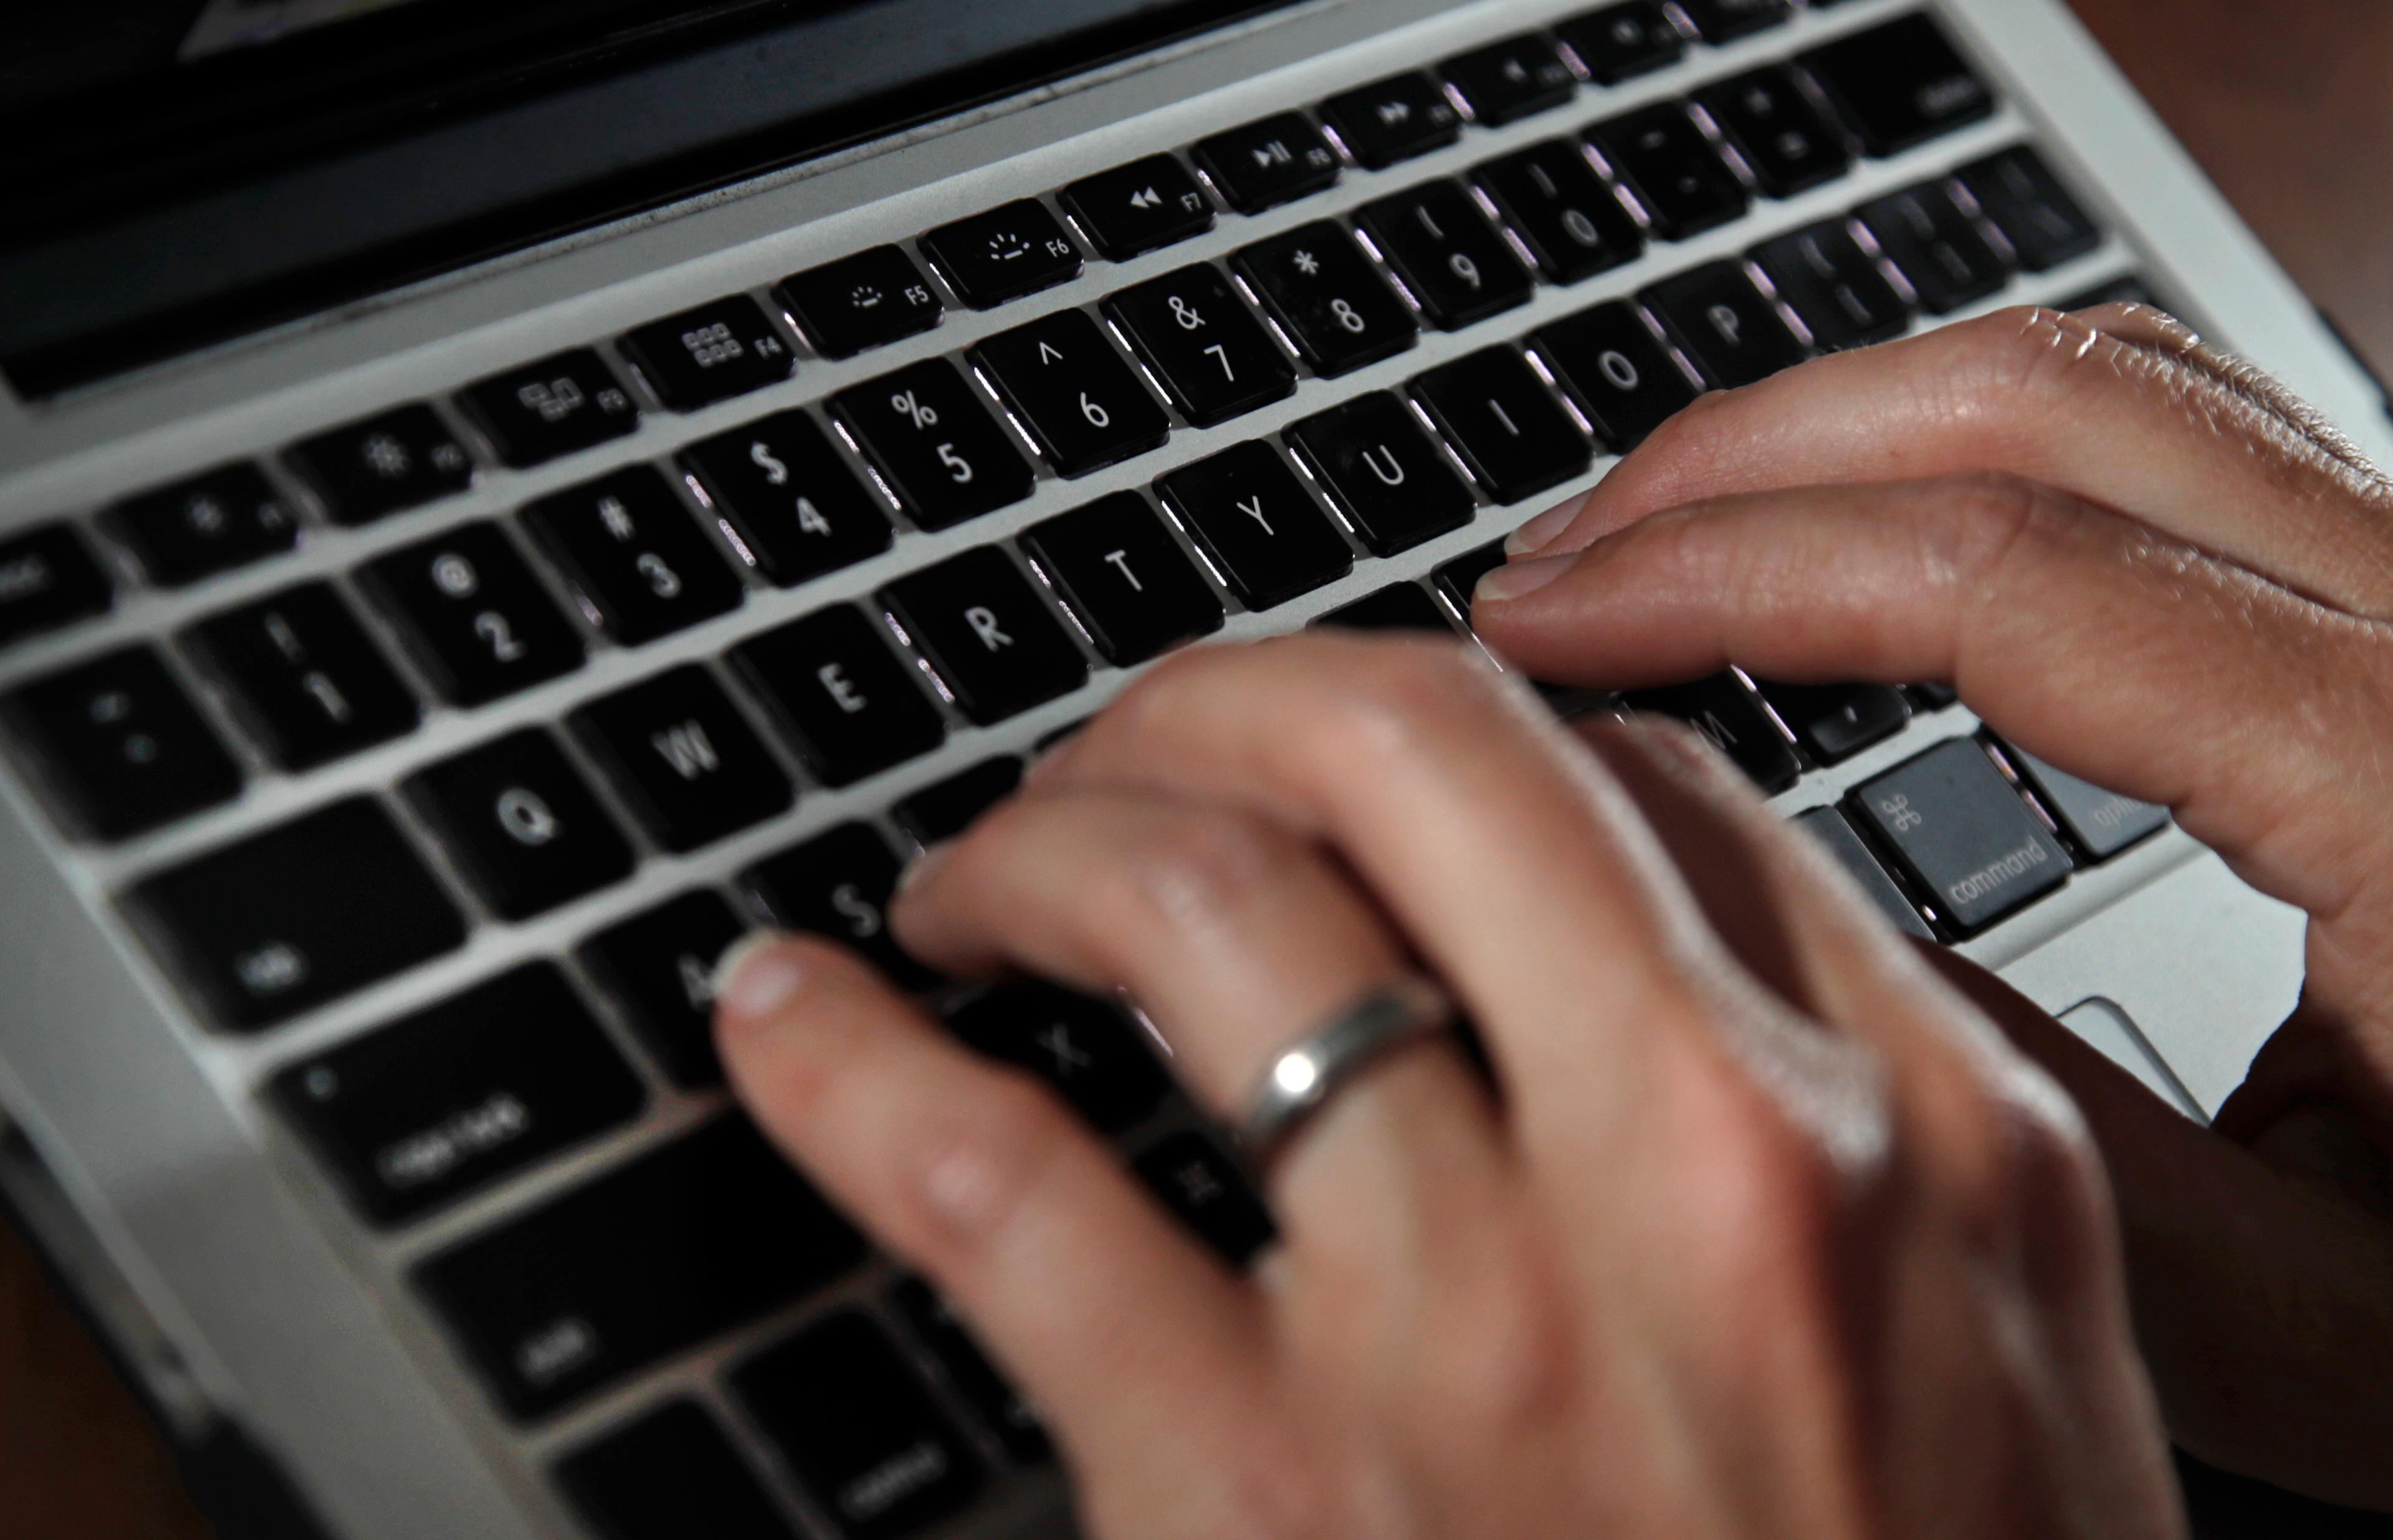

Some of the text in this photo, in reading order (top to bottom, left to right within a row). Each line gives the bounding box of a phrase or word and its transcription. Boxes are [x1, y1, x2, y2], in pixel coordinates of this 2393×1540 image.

[1180, 192, 1202, 211] F7
[1562, 209, 1598, 245] 0
[1045, 238, 1069, 257] F6
[1448, 252, 1482, 292] 9
[904, 285, 929, 306] F5
[1168, 296, 1206, 330] &
[1330, 298, 1365, 333] 8
[754, 336, 782, 358] F4
[1039, 342, 1063, 364] ^
[1203, 344, 1235, 382] 7
[1599, 350, 1639, 390] O
[891, 389, 938, 429] %
[1080, 392, 1109, 427] 6
[750, 442, 787, 484] $
[937, 443, 973, 483] 5
[1362, 444, 1405, 485] U
[795, 496, 833, 538] 4
[1236, 495, 1274, 536] Y
[635, 551, 683, 599] 3
[1104, 549, 1142, 591] T
[472, 609, 527, 663] 2
[965, 606, 1013, 651] R
[816, 661, 867, 714] E
[650, 719, 720, 781] W
[495, 786, 563, 846] Q
[1949, 835, 2048, 905] command
[832, 884, 880, 937] S
[1036, 1022, 1092, 1075] X
